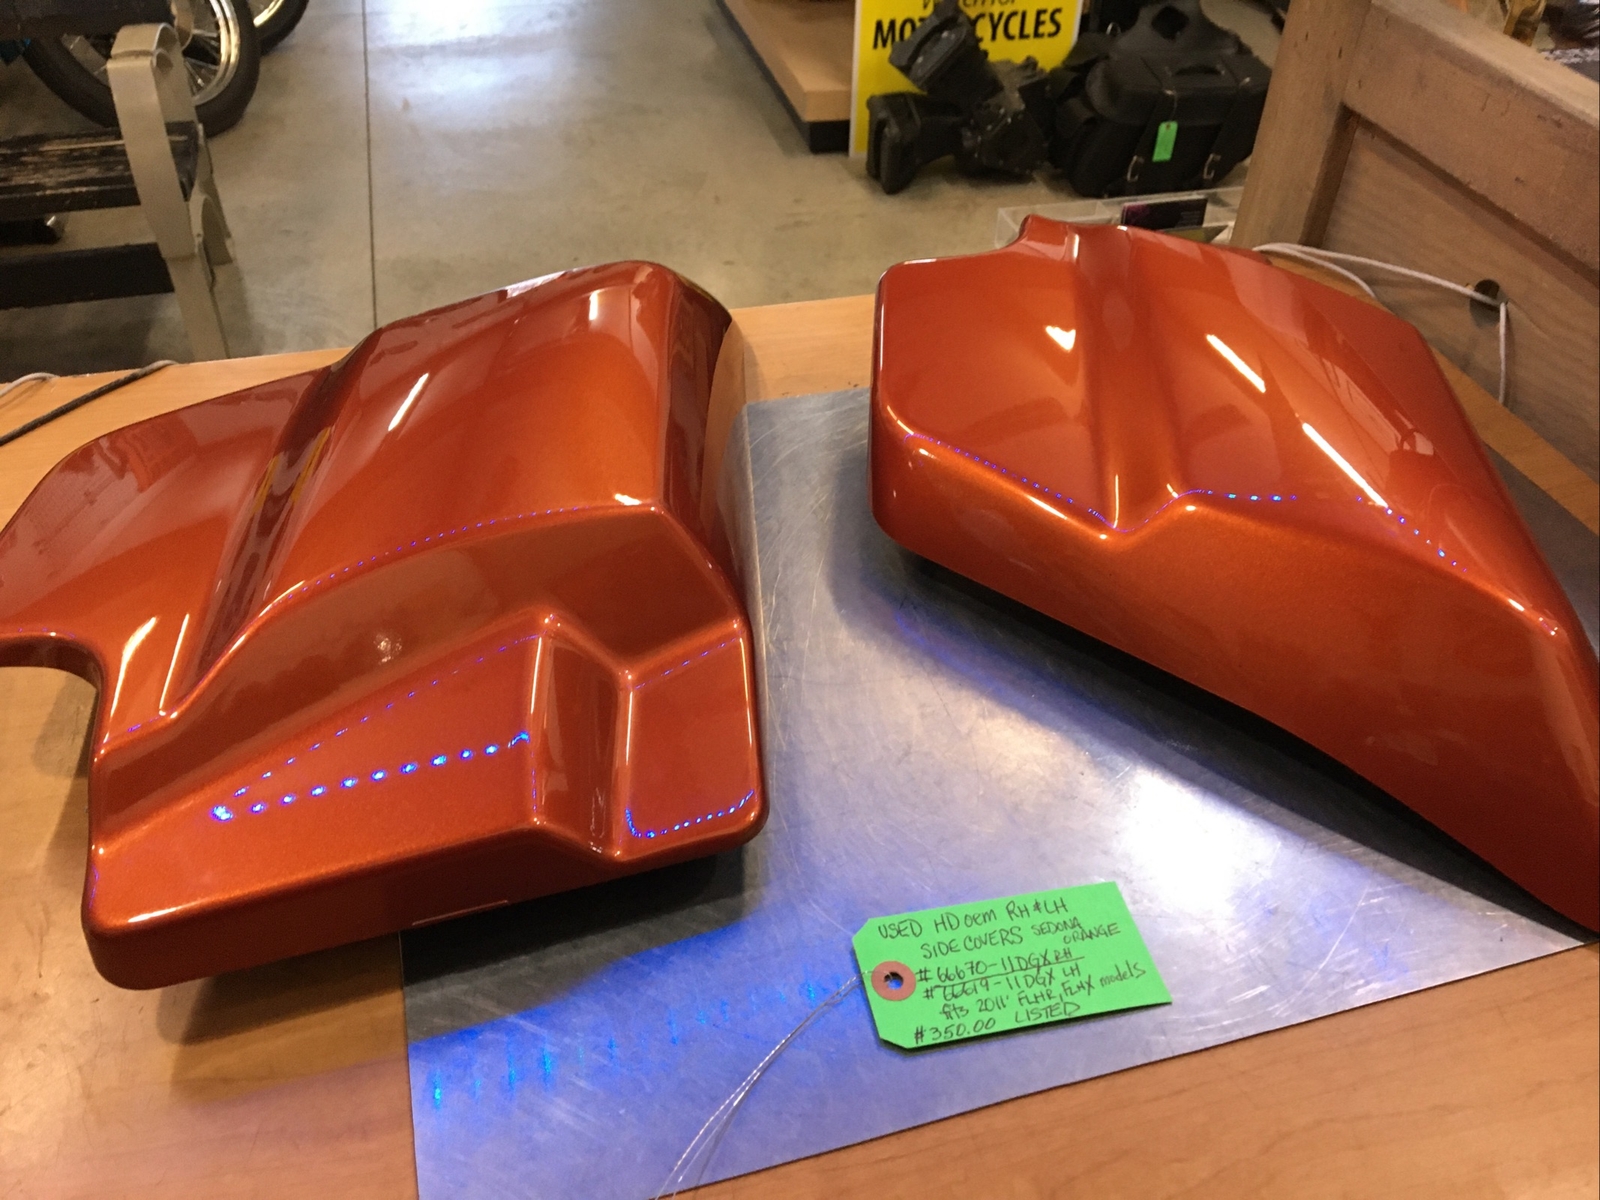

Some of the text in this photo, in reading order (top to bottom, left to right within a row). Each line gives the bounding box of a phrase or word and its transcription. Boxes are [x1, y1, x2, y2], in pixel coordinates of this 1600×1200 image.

[873, 7, 1063, 50] MOCYCLES
[878, 918, 923, 939] USED
[934, 912, 960, 933] HD
[1006, 900, 1030, 921] RH
[1044, 897, 1069, 914] LH
[1063, 922, 1121, 945] ORANGE
[920, 916, 1083, 959] SIDE COVERS SEDONA
[1054, 948, 1073, 961] RH
[1062, 962, 1081, 977] LH
[940, 1003, 969, 1020] fits
[1099, 960, 1147, 987] models
[1015, 1001, 1081, 1024] LISTED
